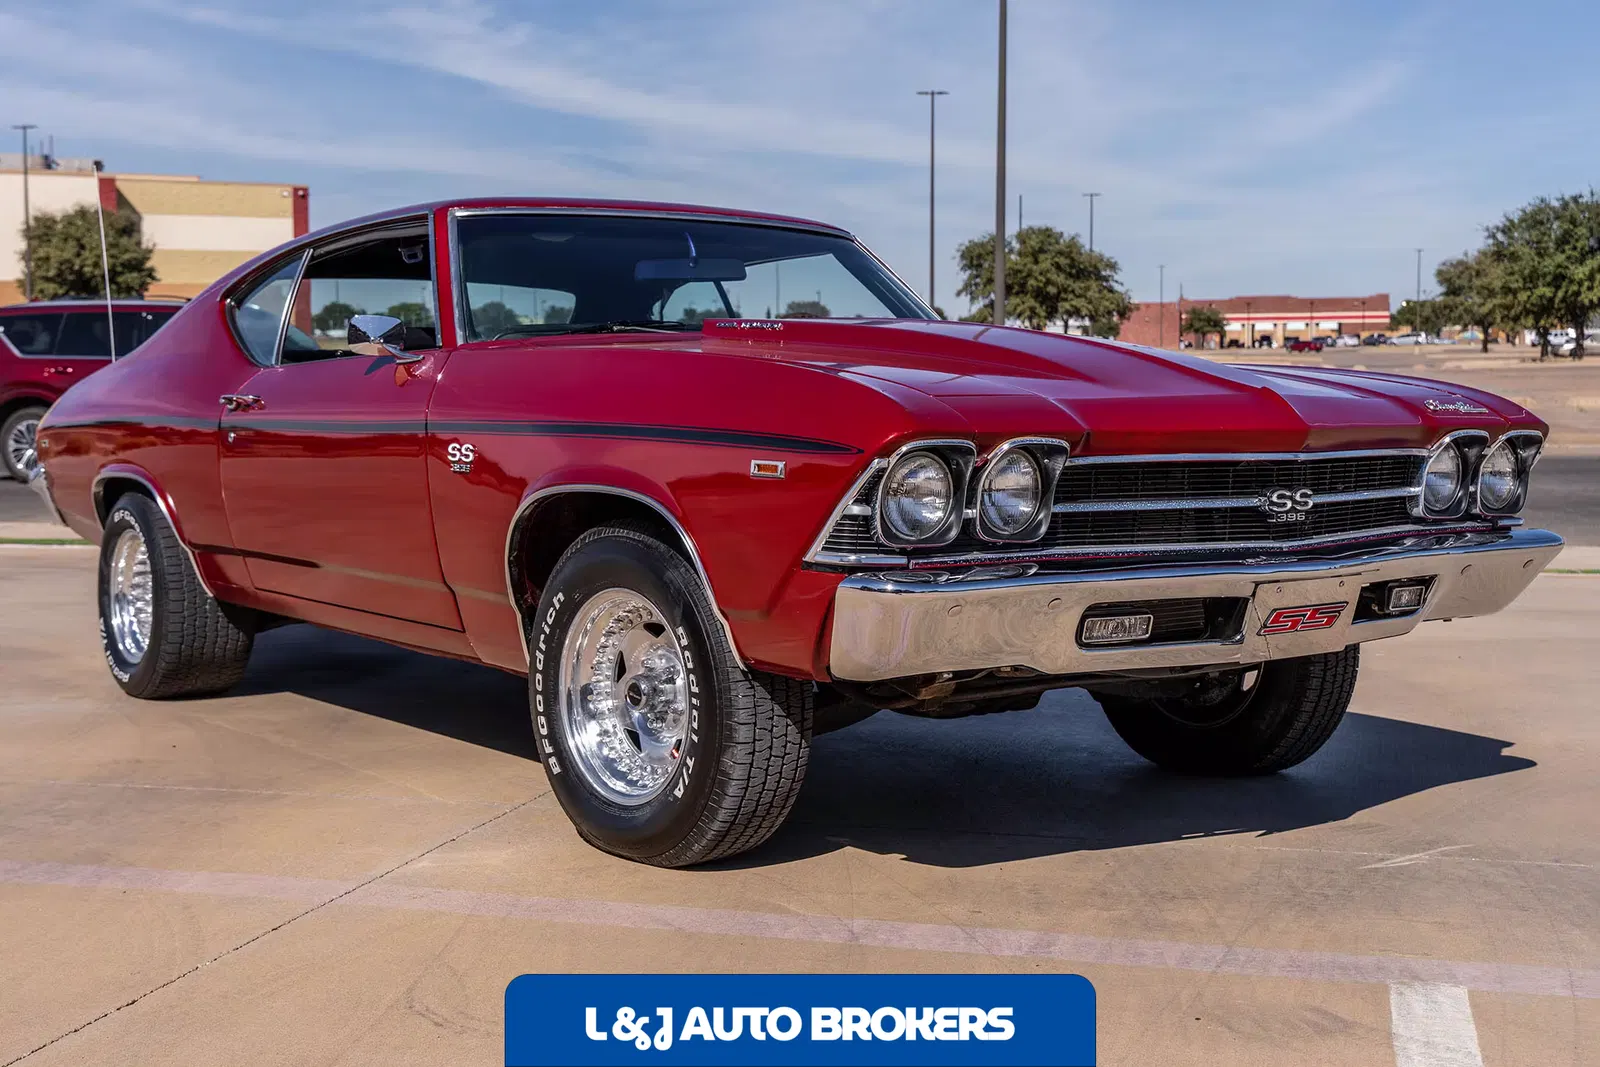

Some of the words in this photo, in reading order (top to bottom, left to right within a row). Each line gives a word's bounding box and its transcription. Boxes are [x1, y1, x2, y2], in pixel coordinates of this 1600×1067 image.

[447, 443, 475, 462] SS
[1271, 489, 1314, 512] SS
[1276, 512, 1306, 522] 396
[1257, 602, 1349, 636] SS
[535, 592, 565, 775] BFGoodrich
[673, 755, 695, 799] T/A
